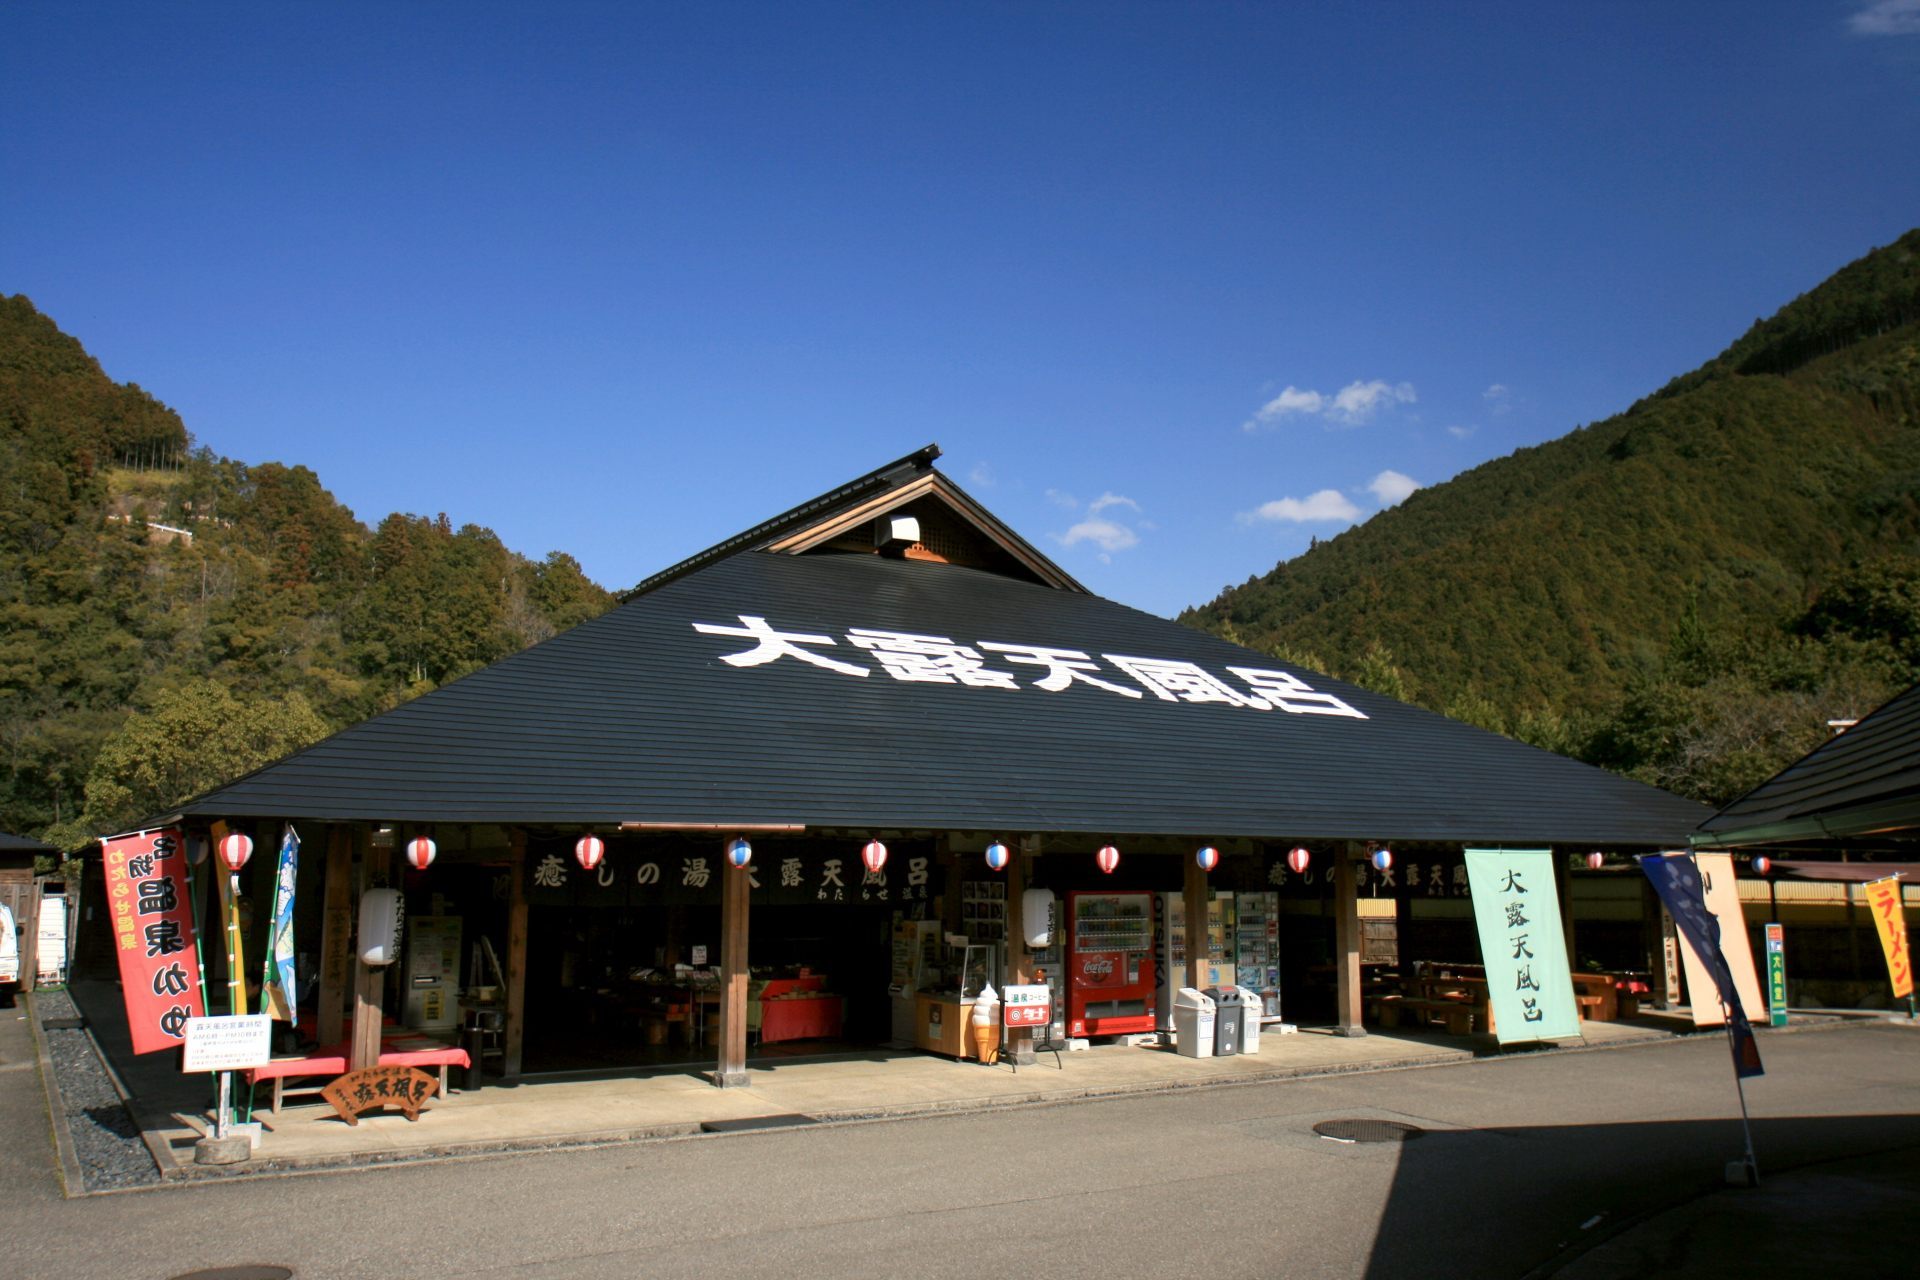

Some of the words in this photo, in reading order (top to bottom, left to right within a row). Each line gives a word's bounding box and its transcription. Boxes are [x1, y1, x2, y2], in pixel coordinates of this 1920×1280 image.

[691, 615, 1370, 720] 大露天風呂
[1153, 895, 1165, 988] OTSUKA
[1499, 869, 1545, 1023] 大露天風呂
[1876, 889, 1907, 985] ラーメン
